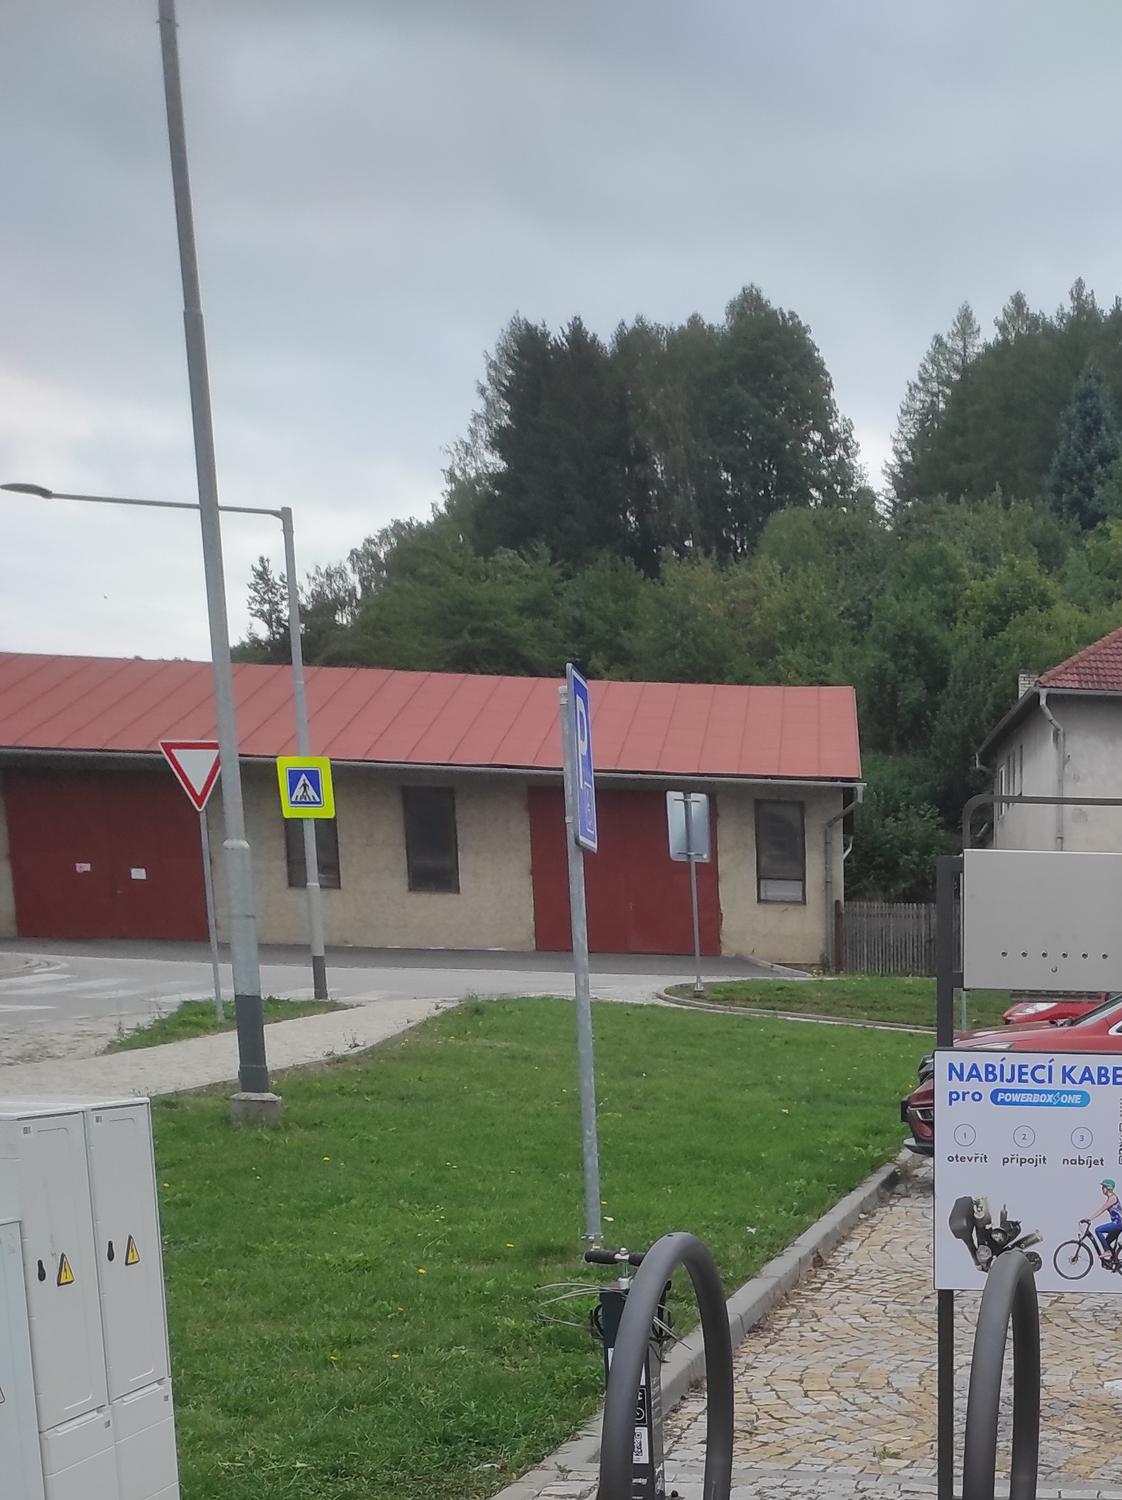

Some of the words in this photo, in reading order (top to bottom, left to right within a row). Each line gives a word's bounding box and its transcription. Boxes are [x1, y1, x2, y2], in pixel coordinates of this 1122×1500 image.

[575, 694, 588, 789] P
[948, 1057, 1055, 1084] NABÍJECÍ
[949, 1090, 983, 1106] pro
[947, 1153, 988, 1164] otevřít
[1002, 1153, 1047, 1167] připojit
[1062, 1154, 1104, 1168] nabíjet
